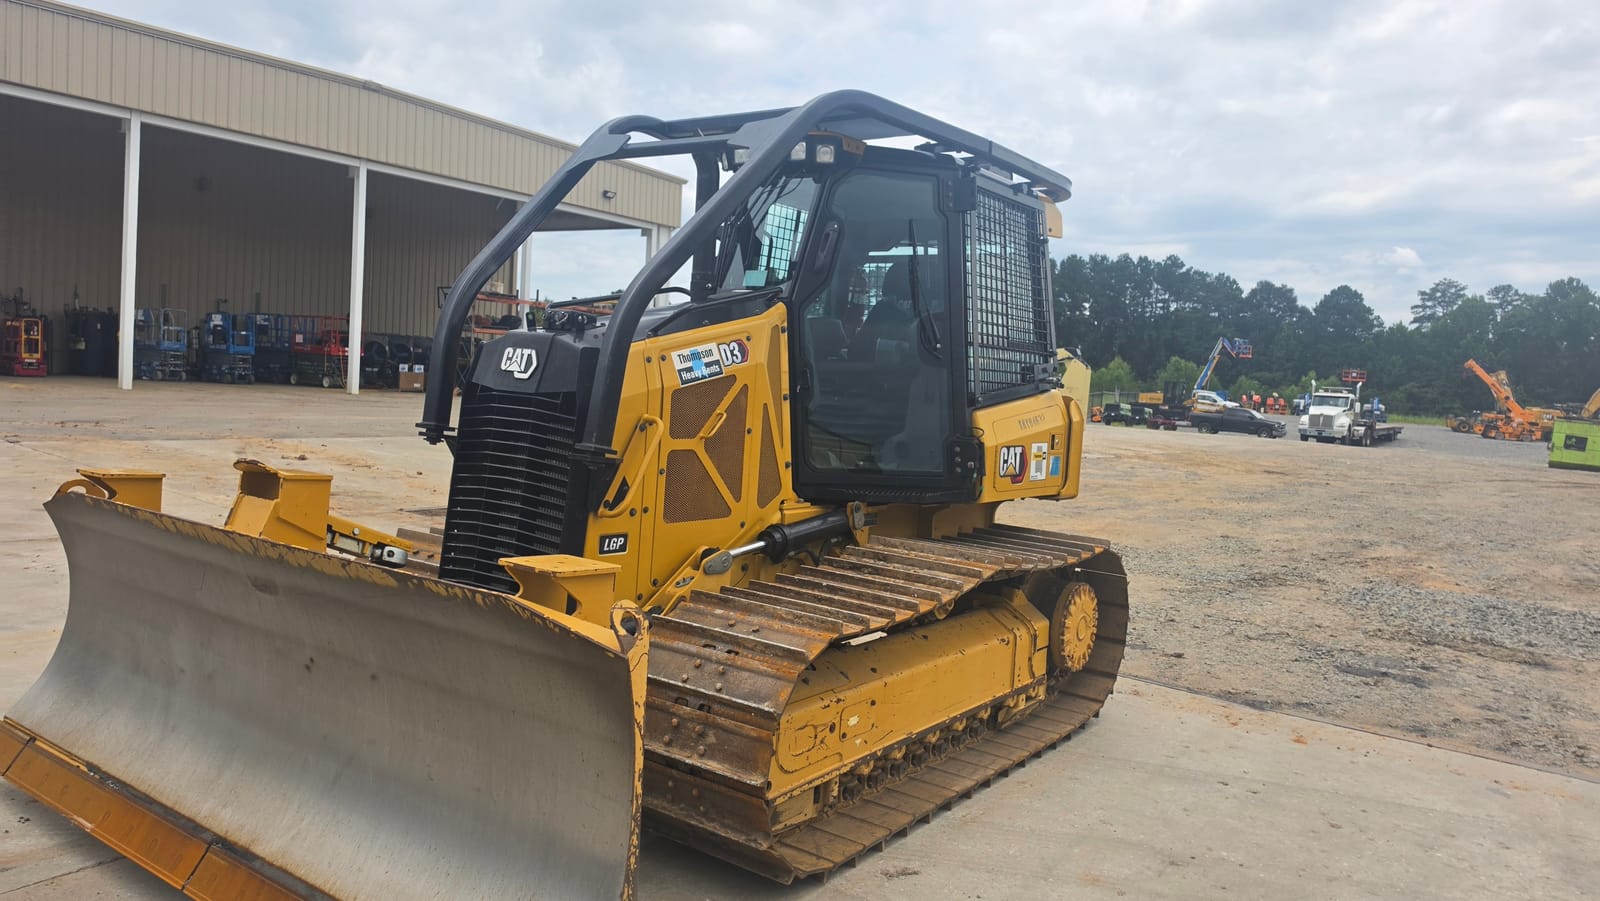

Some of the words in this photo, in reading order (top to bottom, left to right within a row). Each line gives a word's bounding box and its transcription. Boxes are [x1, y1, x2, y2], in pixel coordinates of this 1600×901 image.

[501, 347, 531, 372] CAT
[677, 348, 714, 365] Thompson
[719, 342, 742, 366] D3
[1000, 446, 1023, 477] CAT
[603, 537, 625, 551] LGP
